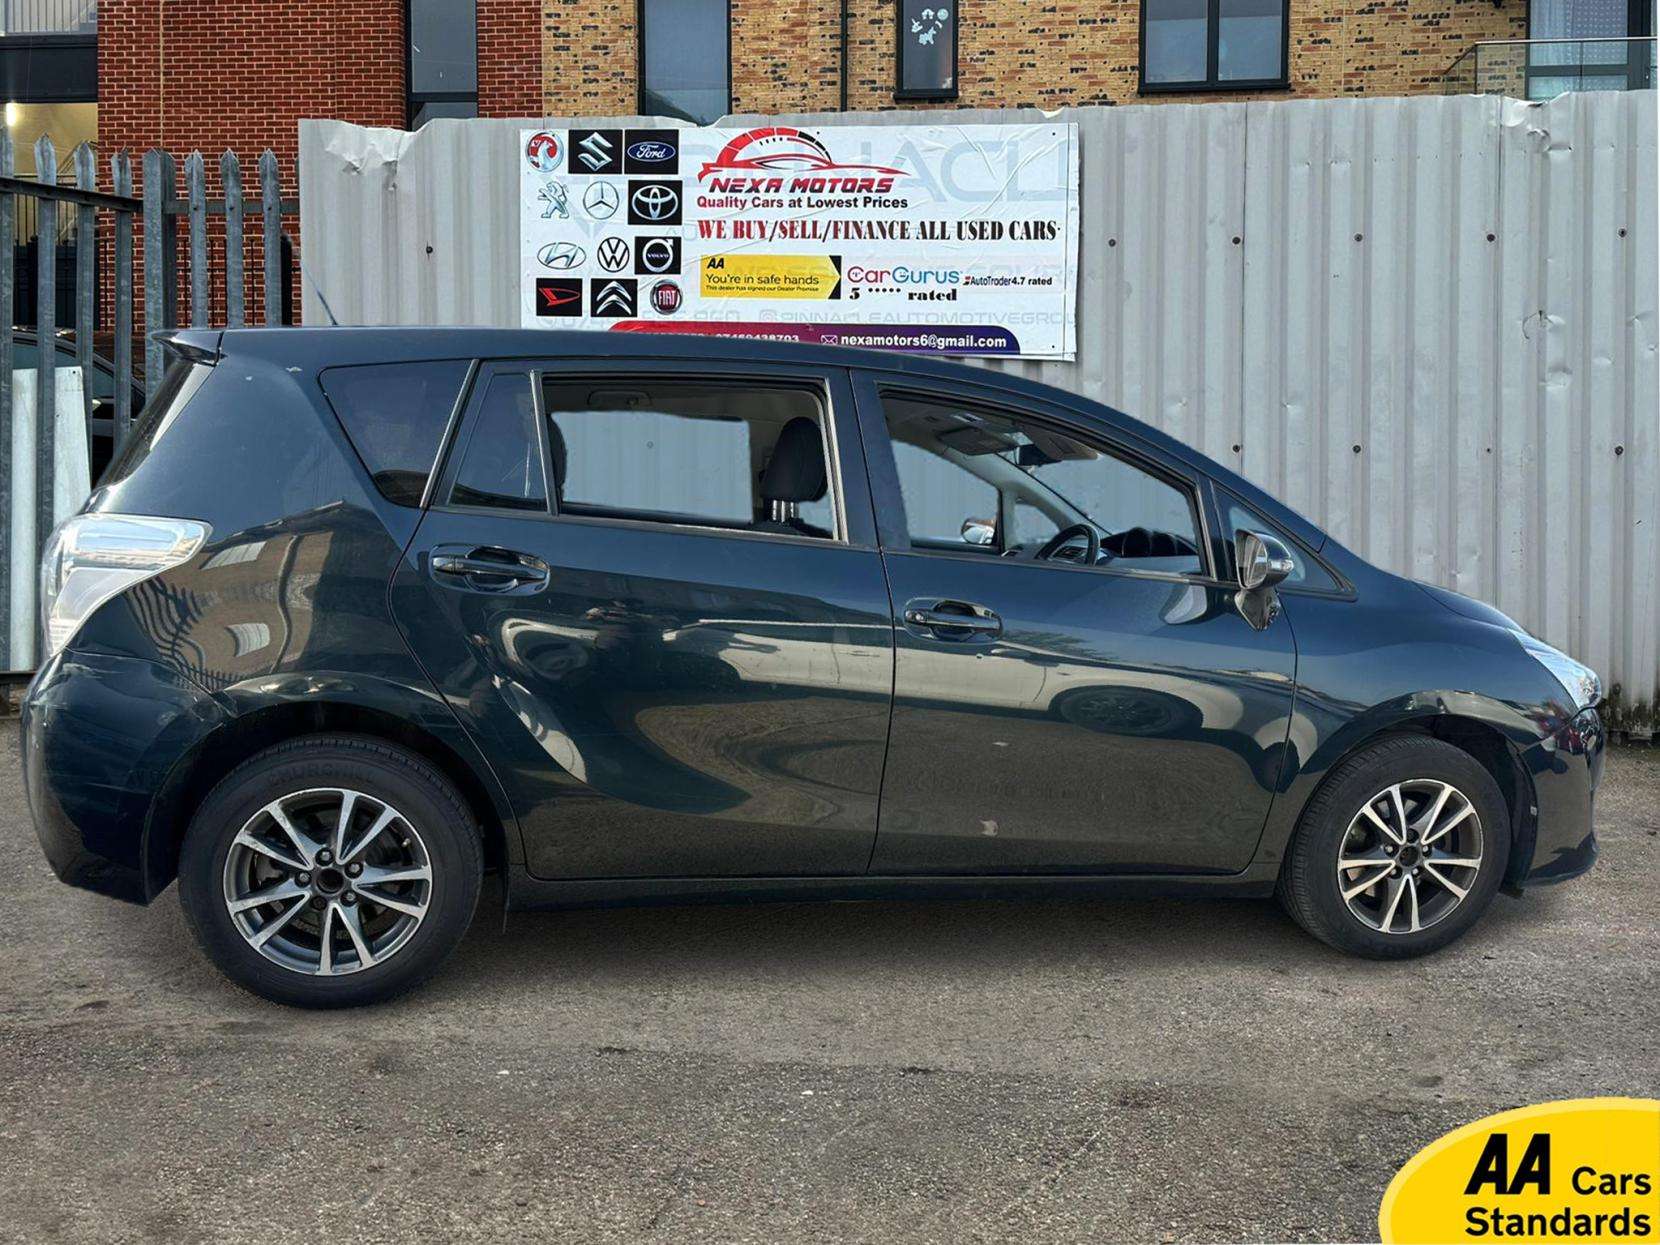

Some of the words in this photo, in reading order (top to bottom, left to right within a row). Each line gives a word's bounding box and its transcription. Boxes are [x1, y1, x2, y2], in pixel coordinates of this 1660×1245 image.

[636, 144, 666, 158] Ford
[709, 177, 784, 194] NEXA
[789, 177, 894, 194] MOTORS
[697, 196, 747, 210] Quality
[752, 196, 784, 208] Cars
[788, 197, 803, 208] at
[807, 196, 859, 208] Lowest
[863, 196, 908, 208] Prices
[697, 219, 727, 240] WE
[916, 220, 950, 240] ALL
[956, 220, 1004, 240] USED
[1009, 220, 1057, 240] CARS
[707, 257, 725, 269] AA
[706, 273, 741, 284] You're
[744, 274, 754, 283] in
[757, 274, 781, 284] safe
[784, 275, 820, 285] hands
[1027, 277, 1053, 286] rated
[659, 290, 676, 305] FIAT
[849, 287, 860, 300] 5
[908, 288, 957, 301] rated
[841, 335, 1007, 349] nexamotors6@gmail.com
